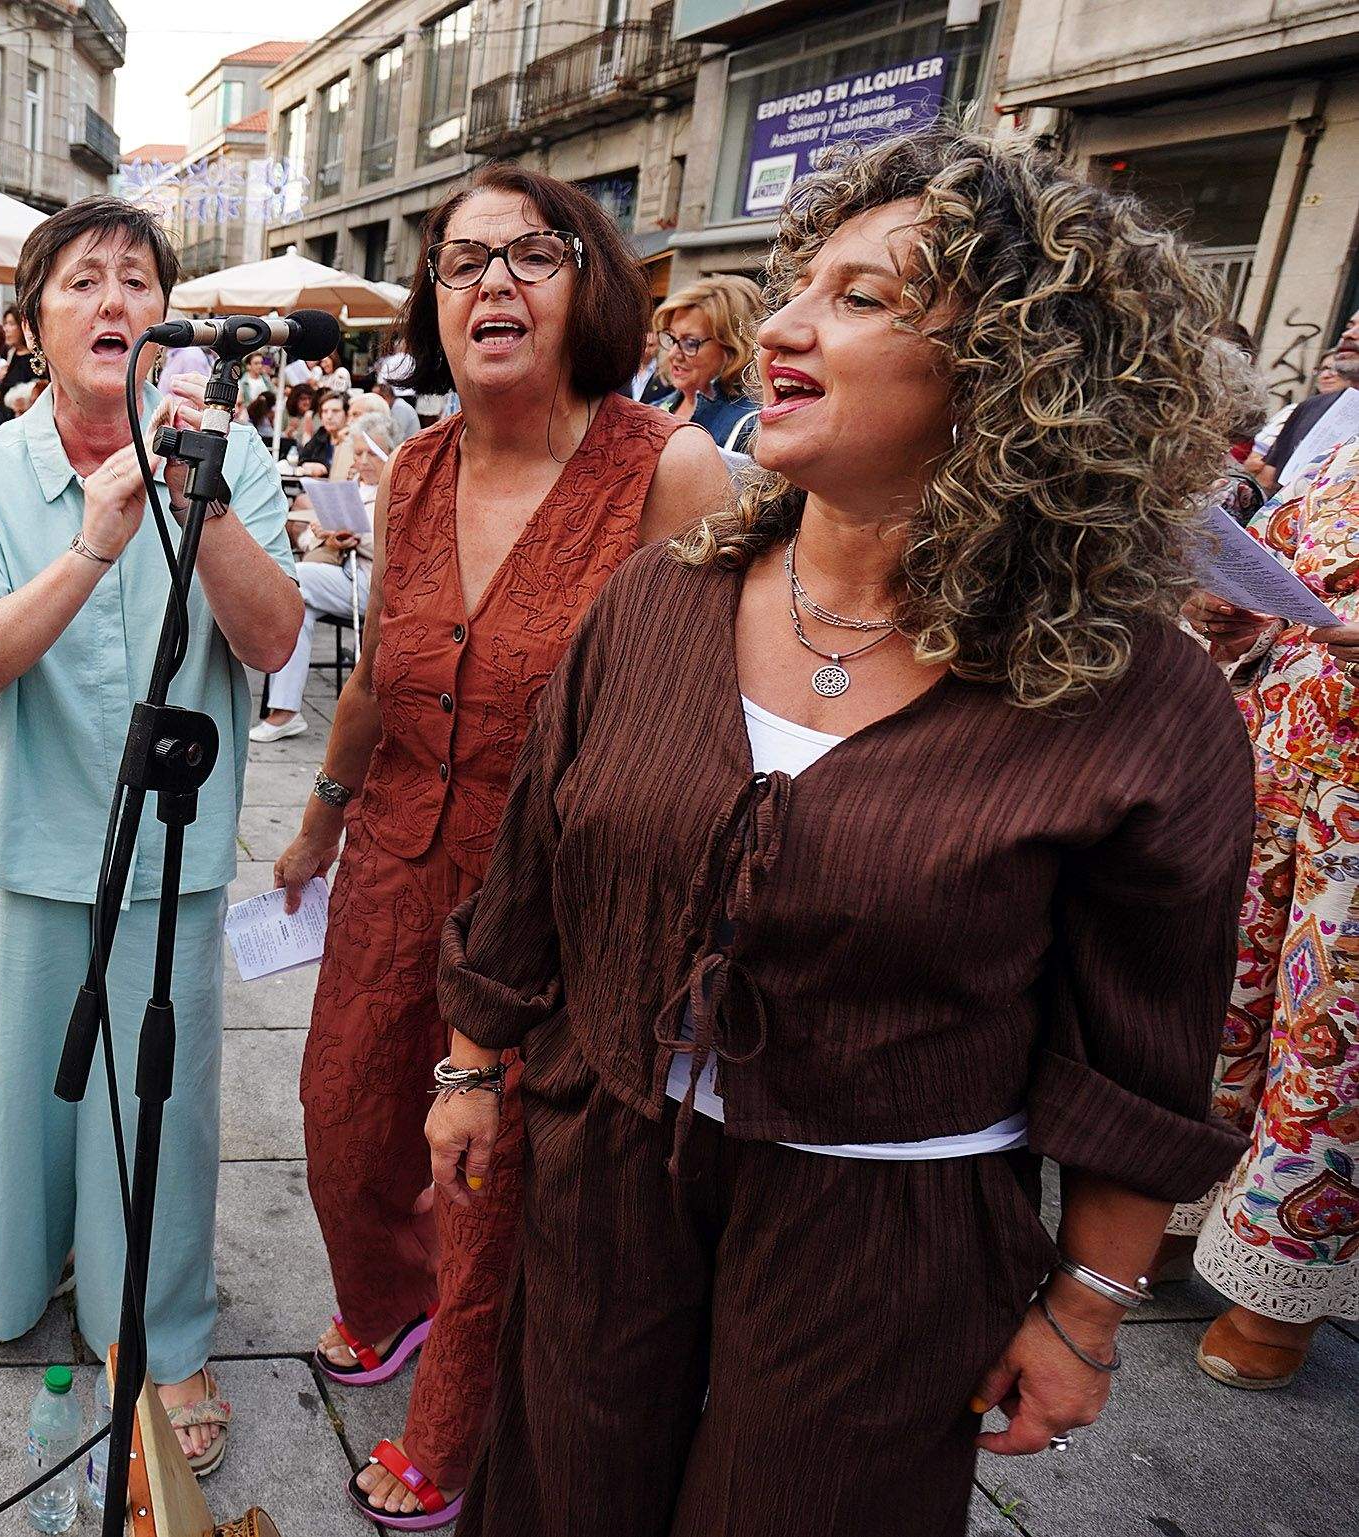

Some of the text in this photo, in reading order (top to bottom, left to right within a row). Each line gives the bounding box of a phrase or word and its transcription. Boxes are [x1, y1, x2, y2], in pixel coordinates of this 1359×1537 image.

[757, 57, 943, 120] EDIFICIO EN ALQUILER
[828, 107, 837, 124] y
[838, 102, 848, 119] 5
[849, 94, 895, 118] plantas
[770, 107, 912, 148] Ascensor y montacargas
